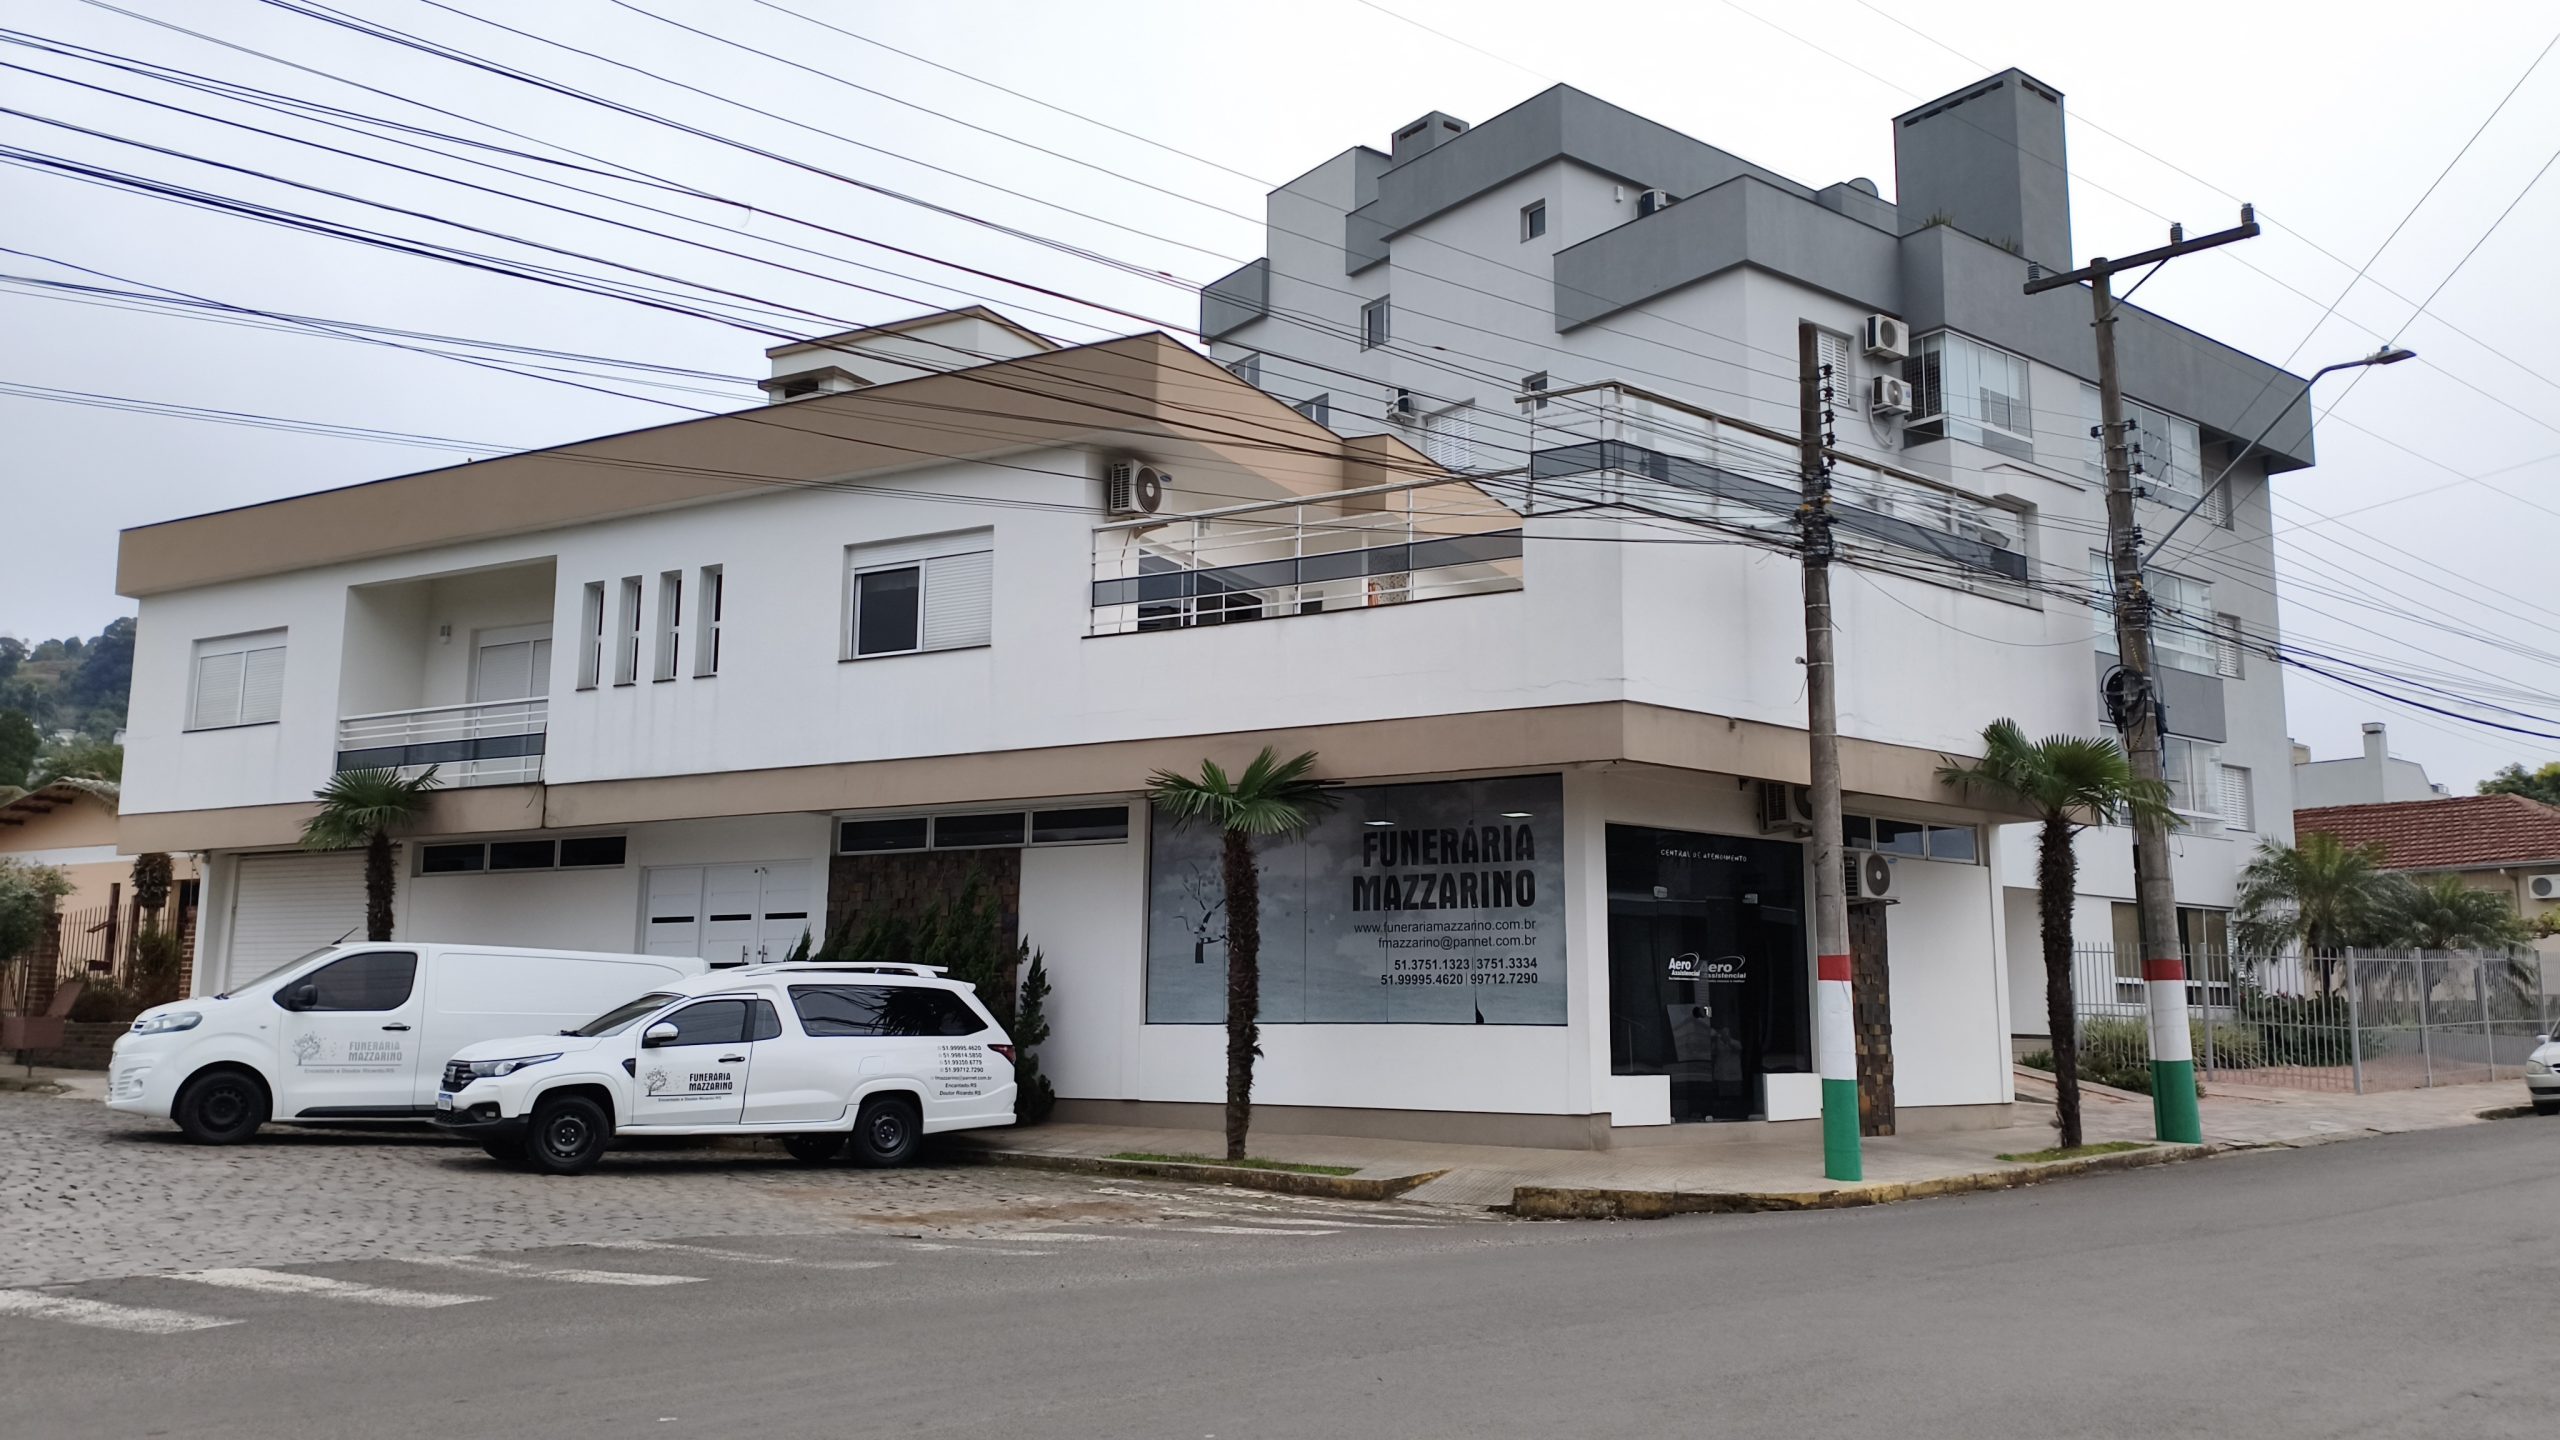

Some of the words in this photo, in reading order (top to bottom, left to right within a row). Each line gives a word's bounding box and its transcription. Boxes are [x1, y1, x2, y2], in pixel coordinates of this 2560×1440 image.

[1363, 819, 1535, 867] FUNERÁRIA
[1353, 869, 1536, 911] MAZZARINO
[1354, 918, 1537, 934] www.funerariamazzarino.com.br
[1378, 935, 1537, 950] fmazzarino@pannet.com.br
[1394, 958, 1470, 971] 51.3751.1323
[1476, 957, 1538, 970] 3751.3334
[1668, 957, 1692, 970] Aero
[1380, 974, 1463, 986] 51.99995.4620
[1470, 972, 1539, 985] 99712.7290
[348, 1051, 402, 1062] MAZZARINO
[688, 1082, 733, 1091] MAZZARINO
